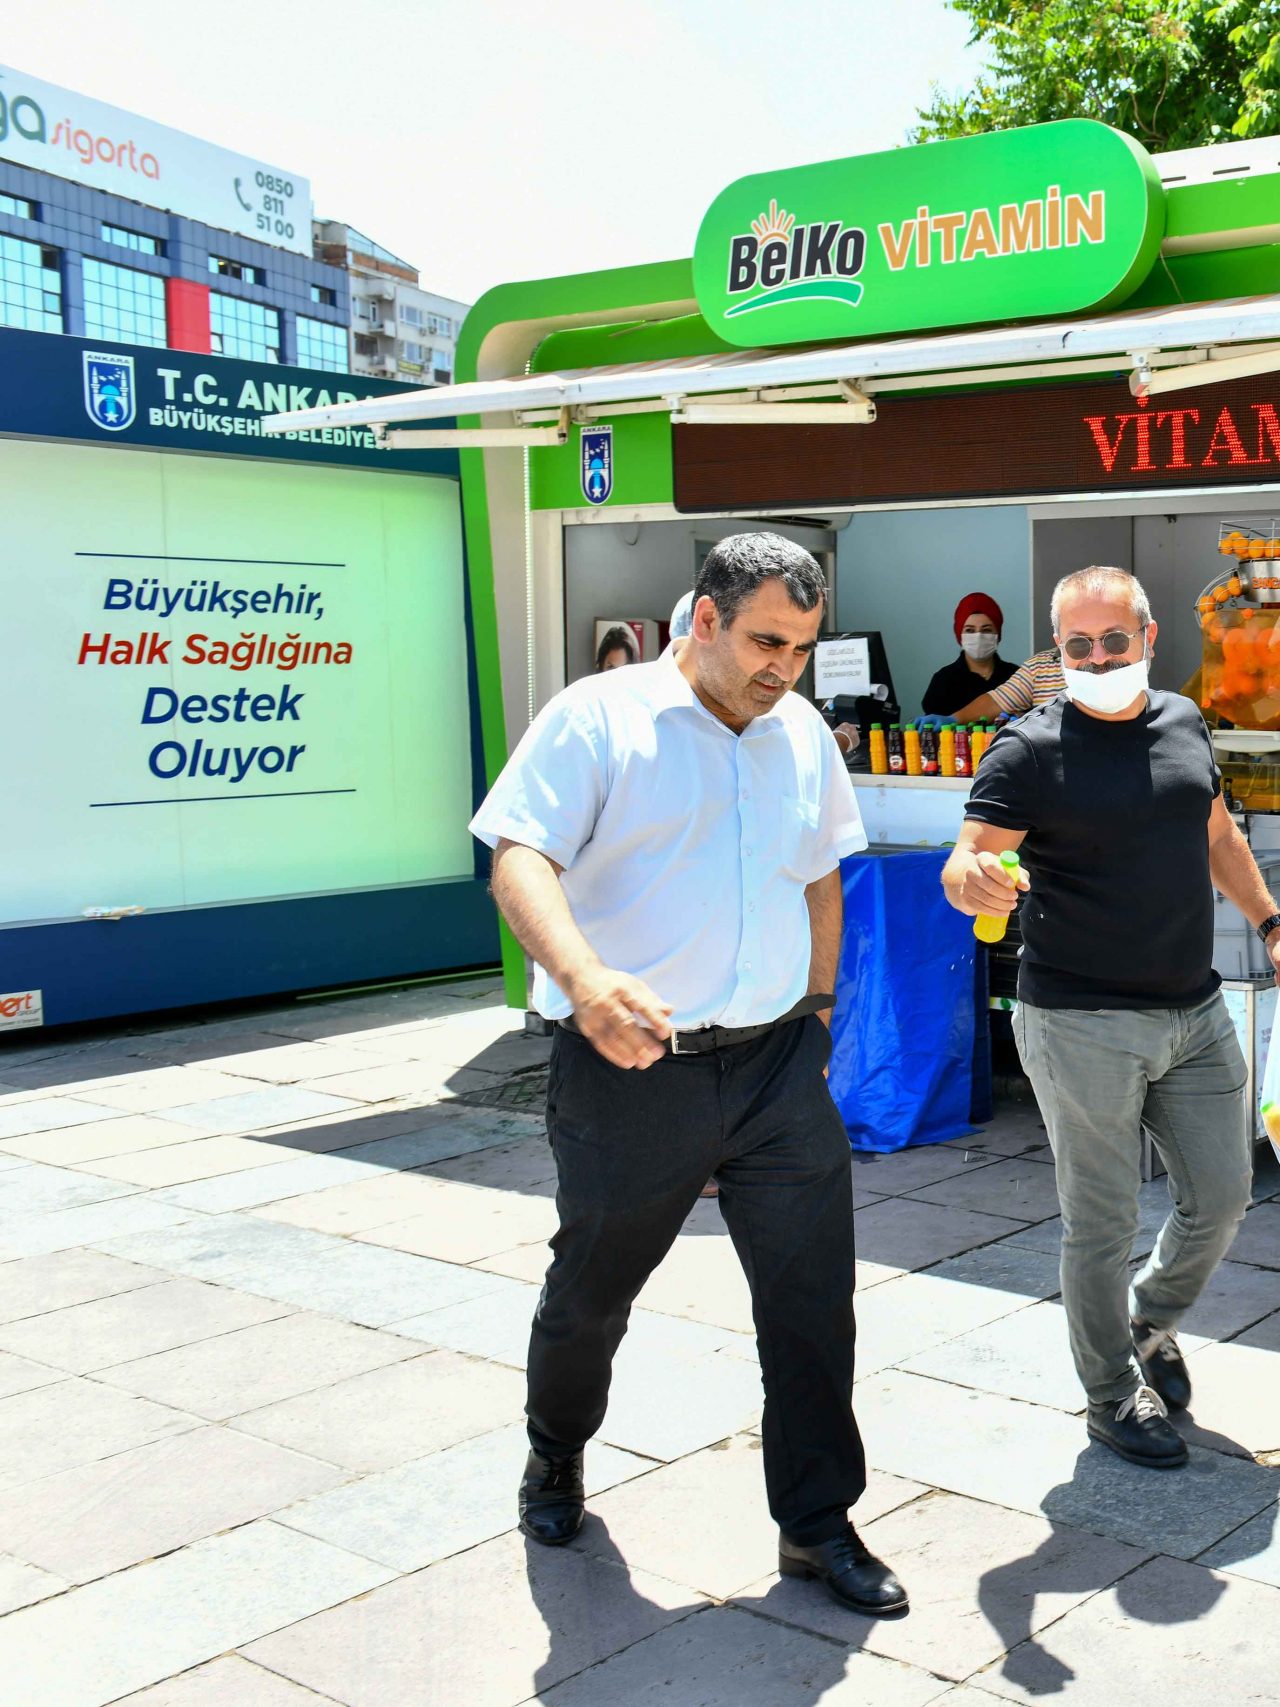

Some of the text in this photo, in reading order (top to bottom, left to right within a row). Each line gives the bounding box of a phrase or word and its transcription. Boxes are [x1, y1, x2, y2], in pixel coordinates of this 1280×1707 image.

[0, 74, 160, 180] a sigorta
[255, 171, 294, 198] 0850
[263, 194, 285, 216] 811
[256, 213, 294, 240] 51 00
[727, 185, 1105, 294] BelKo VİTAMİN
[157, 368, 375, 412] T.C. ANKA
[285, 426, 391, 450] BELEDİYE
[103, 578, 324, 621] Büyükşehir,
[77, 632, 353, 672] Halk Sağlığına
[141, 684, 306, 724] Destek
[148, 739, 306, 783] Oluyor
[0, 993, 33, 1018] ert
